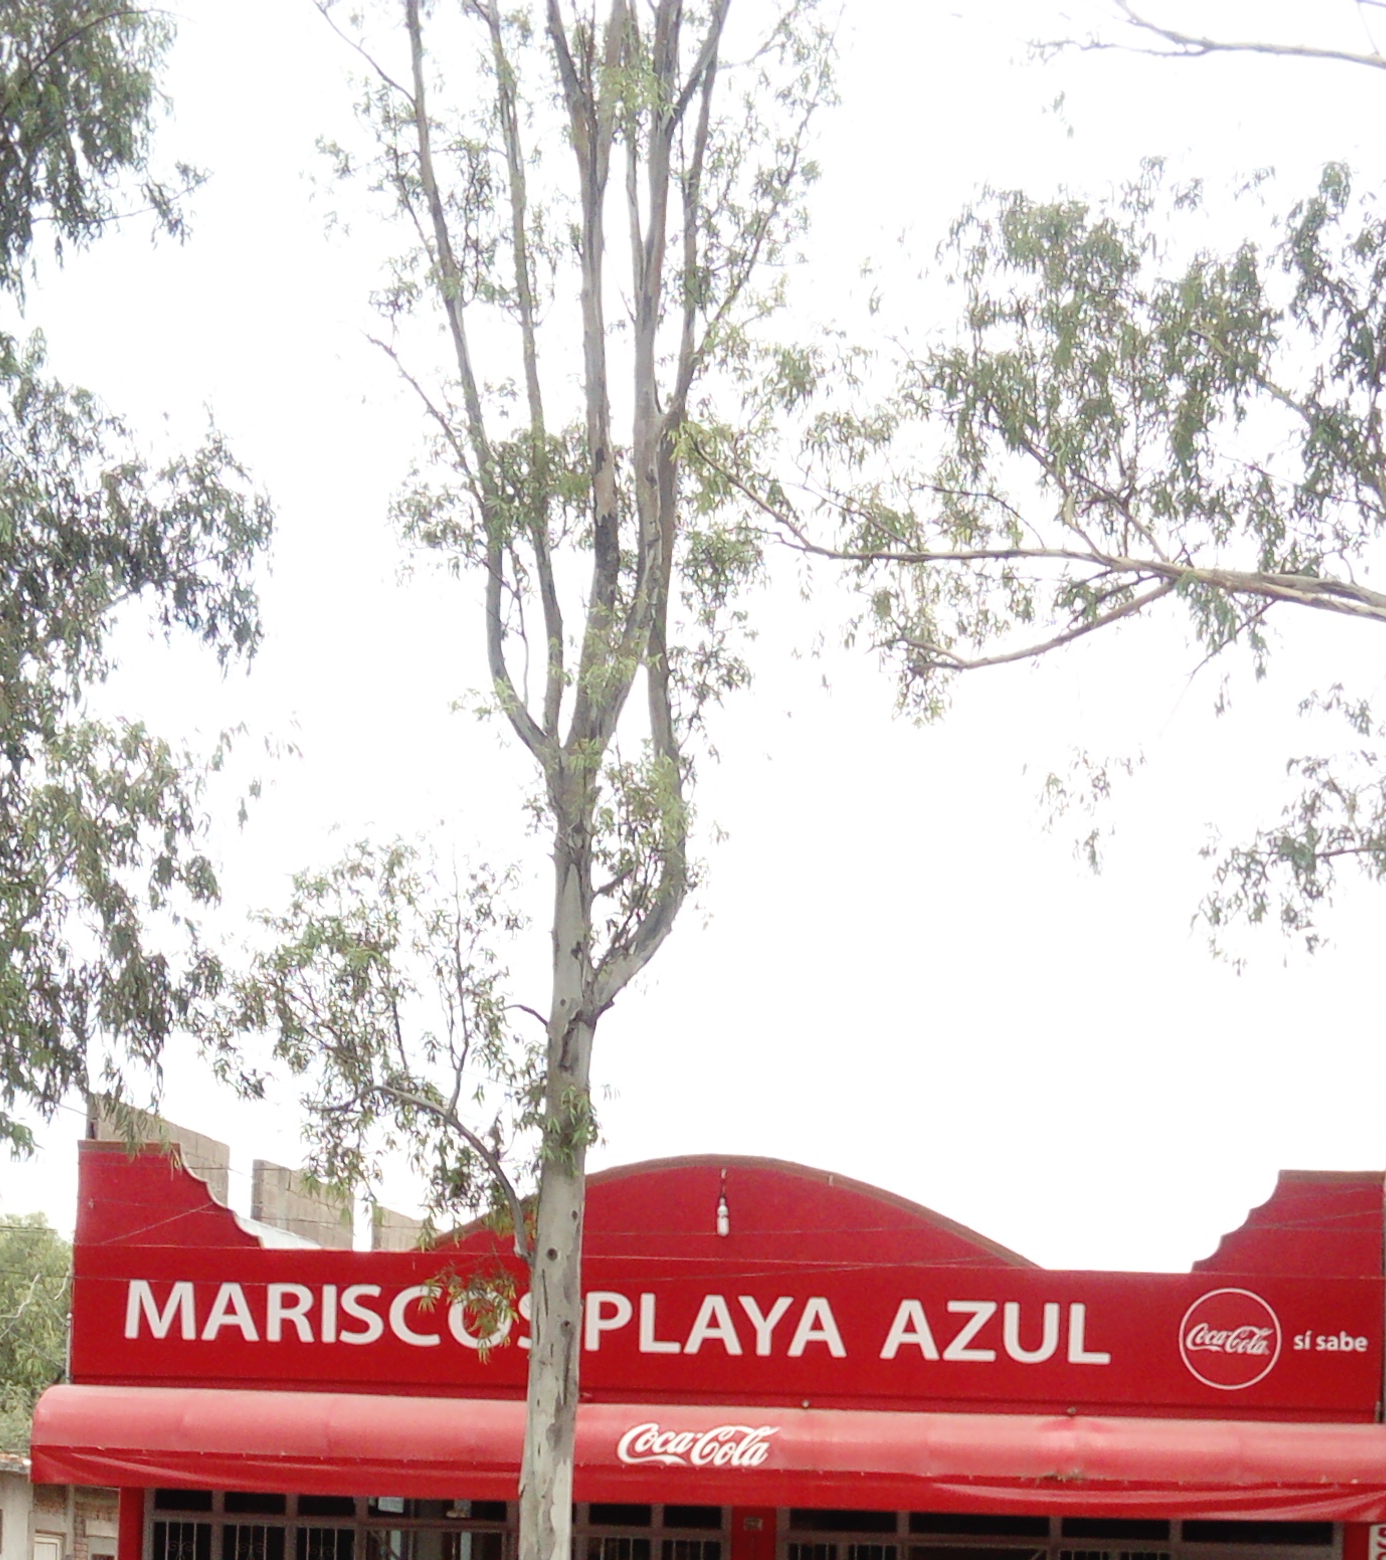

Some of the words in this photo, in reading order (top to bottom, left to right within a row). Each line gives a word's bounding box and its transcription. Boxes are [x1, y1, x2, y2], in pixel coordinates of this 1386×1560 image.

[123, 1279, 532, 1348] MARISCO
[584, 1291, 847, 1357] PLAYA
[879, 1298, 1111, 1365] AZUL
[1186, 1323, 1274, 1355] Coca-Cola
[1293, 1331, 1312, 1350] sí
[1315, 1331, 1369, 1352] sabe
[618, 1422, 780, 1466] Coca-Cola
